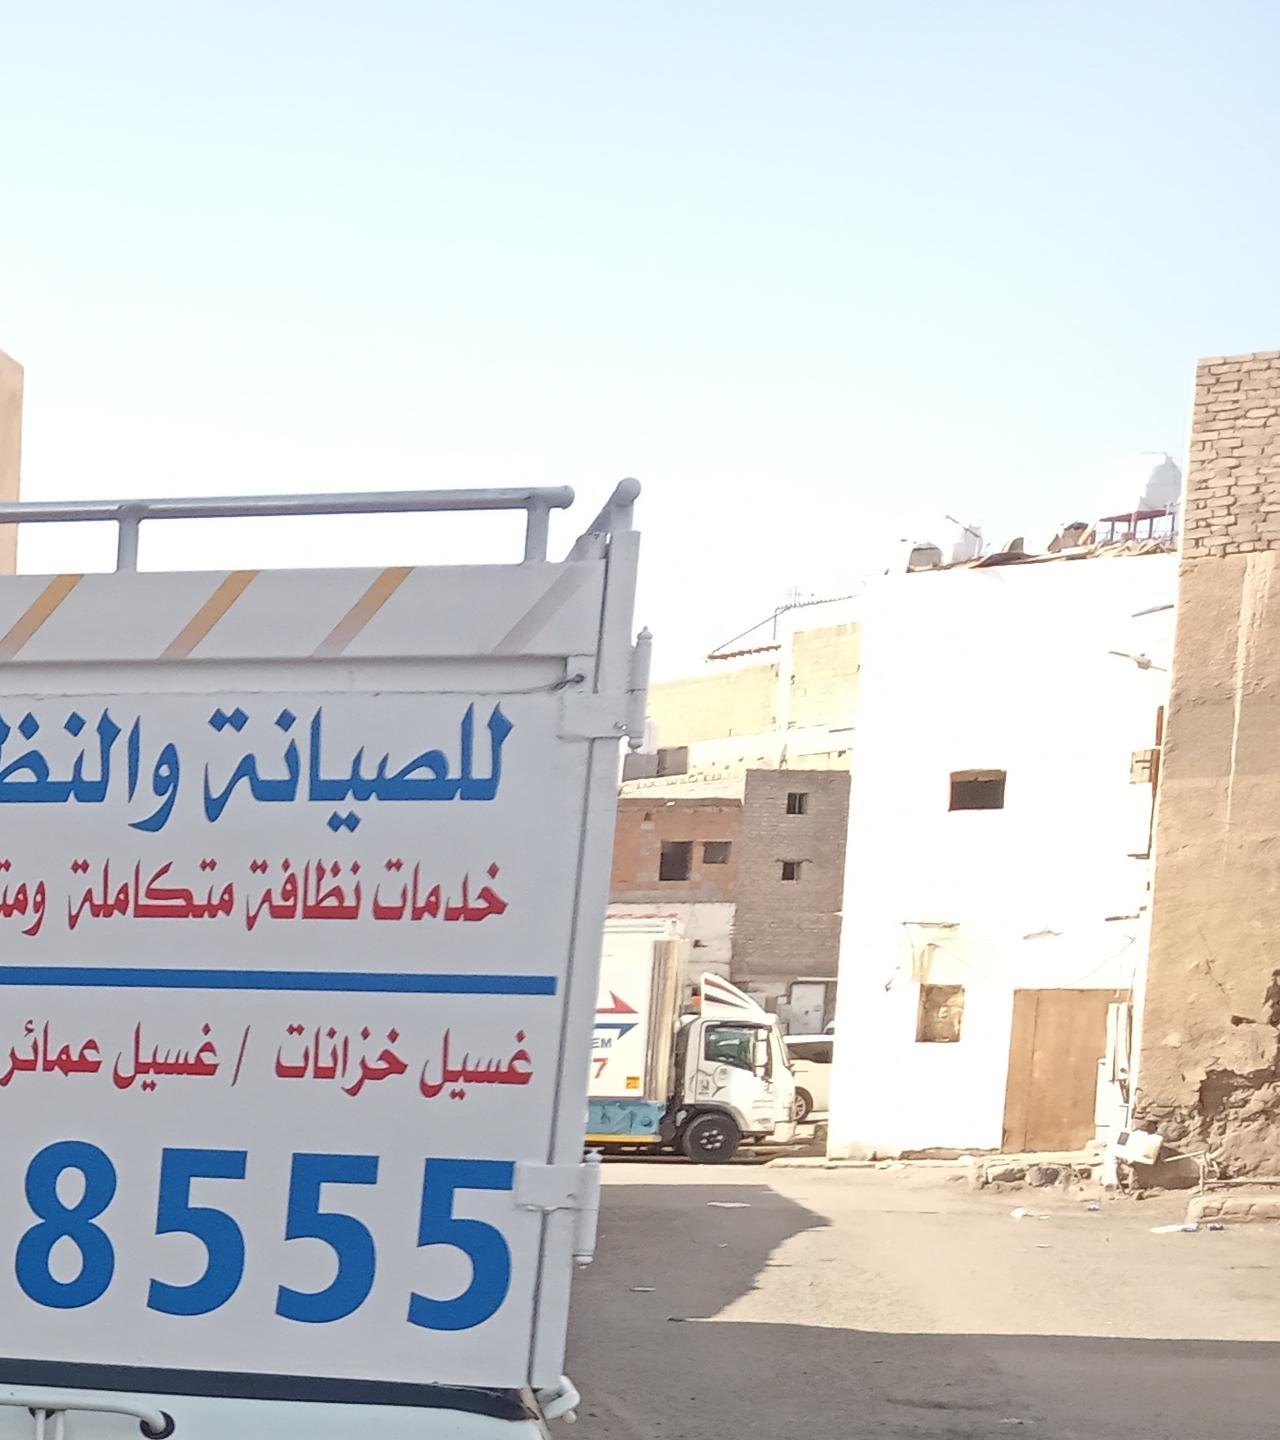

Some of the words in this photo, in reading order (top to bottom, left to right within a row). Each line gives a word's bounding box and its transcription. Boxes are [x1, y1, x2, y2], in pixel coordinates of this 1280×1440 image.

[203, 702, 514, 832] للصيانة
[67, 857, 235, 930] متكاملة
[245, 857, 361, 931] نظافة
[371, 857, 509, 923] خدمات
[113, 1021, 220, 1092] غسيل
[275, 1023, 409, 1097] خزانات
[419, 1028, 534, 1101] غسيل
